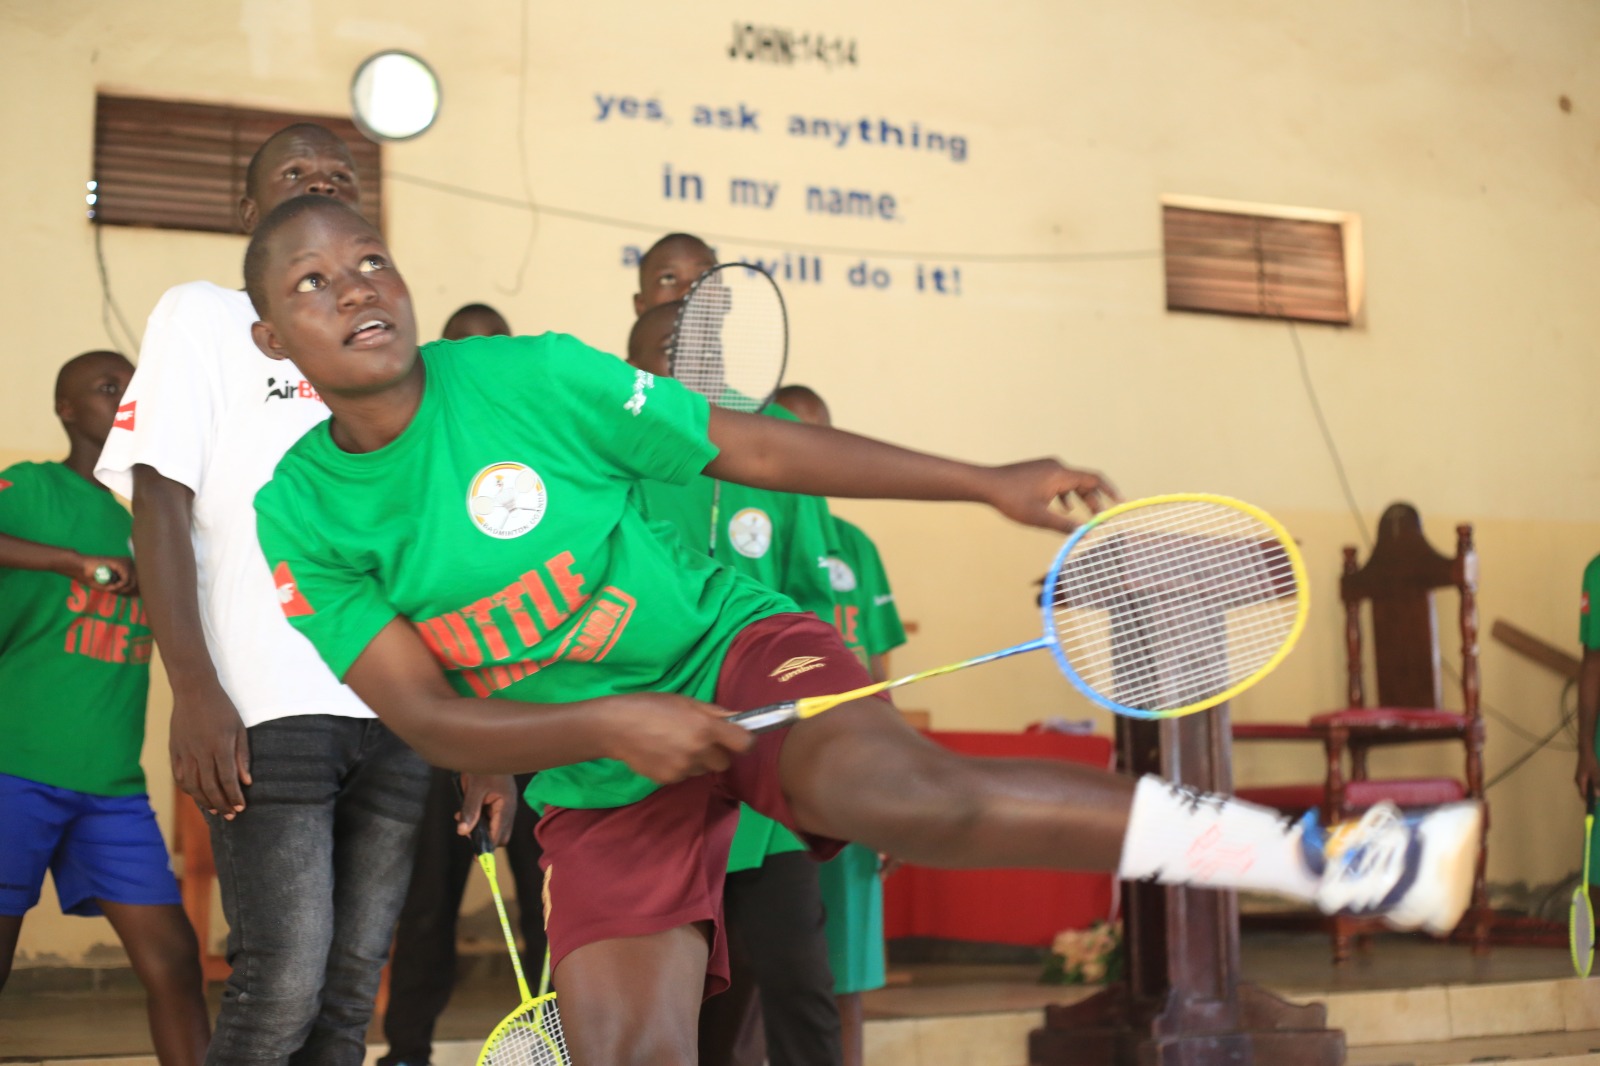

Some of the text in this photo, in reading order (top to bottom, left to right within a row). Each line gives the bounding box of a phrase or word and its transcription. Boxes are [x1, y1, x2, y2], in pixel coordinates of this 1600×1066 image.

[692, 103, 759, 132] ask
[788, 114, 969, 161] anything
[662, 164, 704, 203] in
[731, 176, 779, 208] my
[741, 253, 822, 283] will
[849, 262, 890, 290] do
[916, 265, 961, 295] it!
